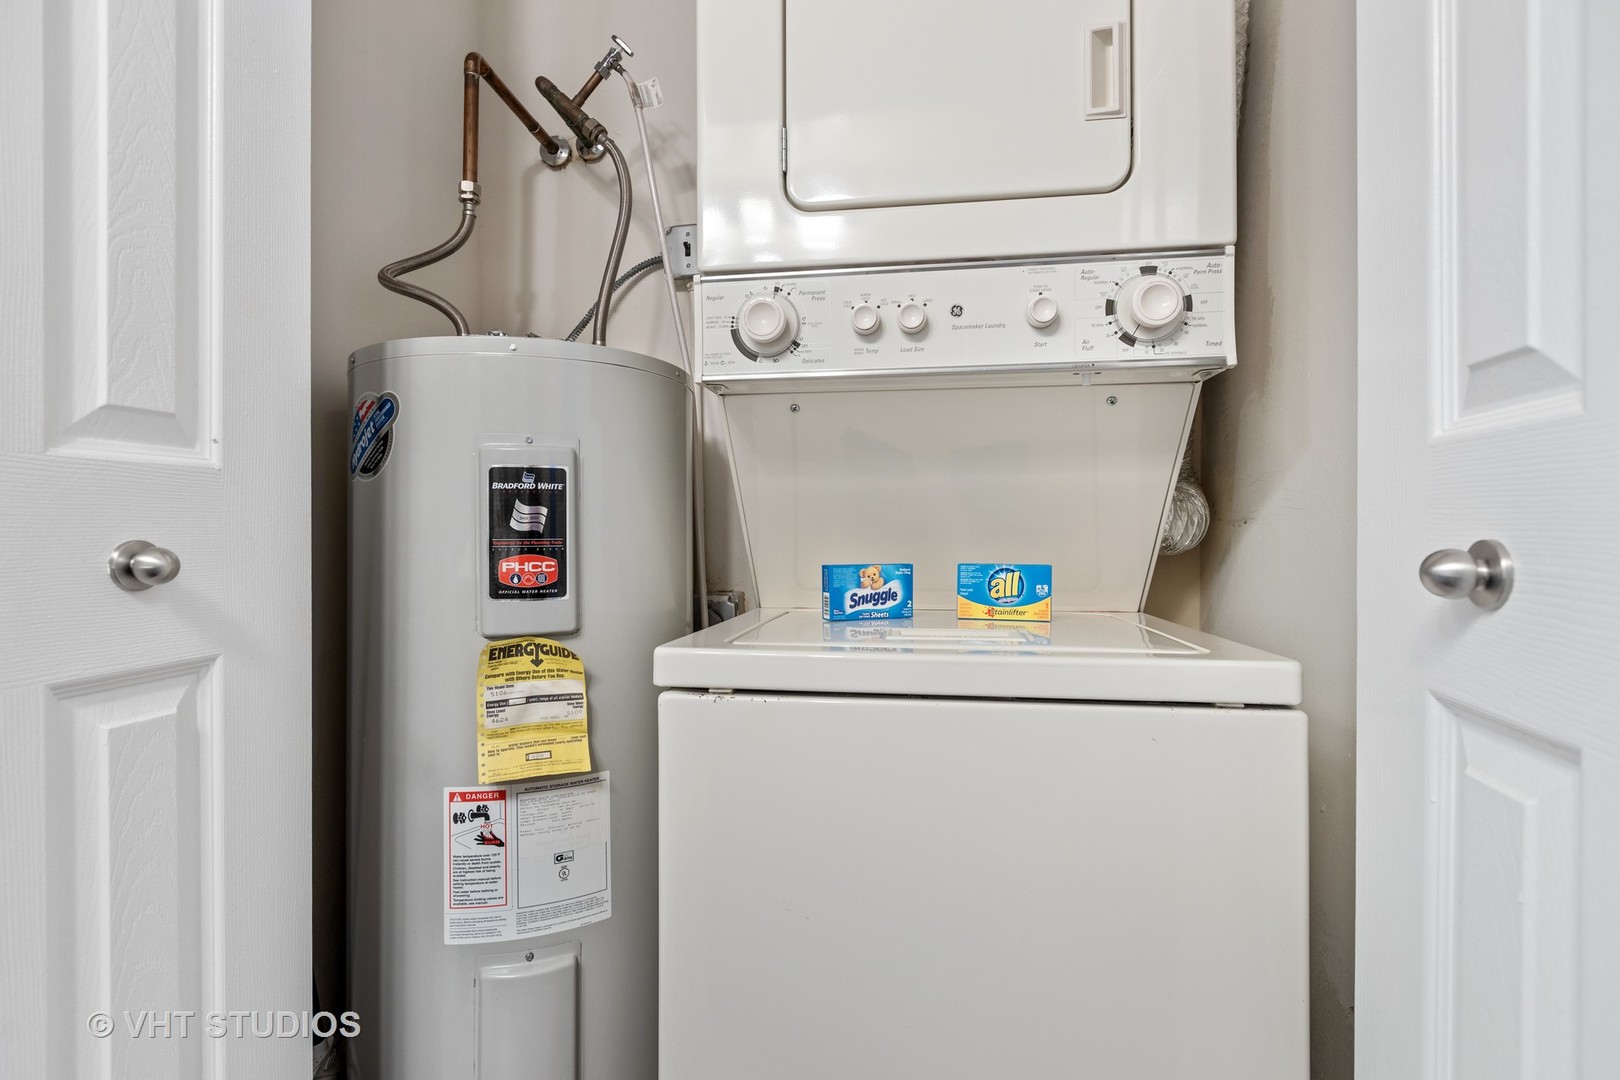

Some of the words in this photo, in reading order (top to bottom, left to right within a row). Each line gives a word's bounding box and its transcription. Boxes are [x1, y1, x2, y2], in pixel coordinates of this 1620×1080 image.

[502, 561, 555, 572] PHCC
[990, 570, 1021, 599] all
[849, 587, 898, 609] Snuggle
[989, 608, 1026, 616] Stainlifter
[488, 642, 580, 662] ENERGYGUIDE
